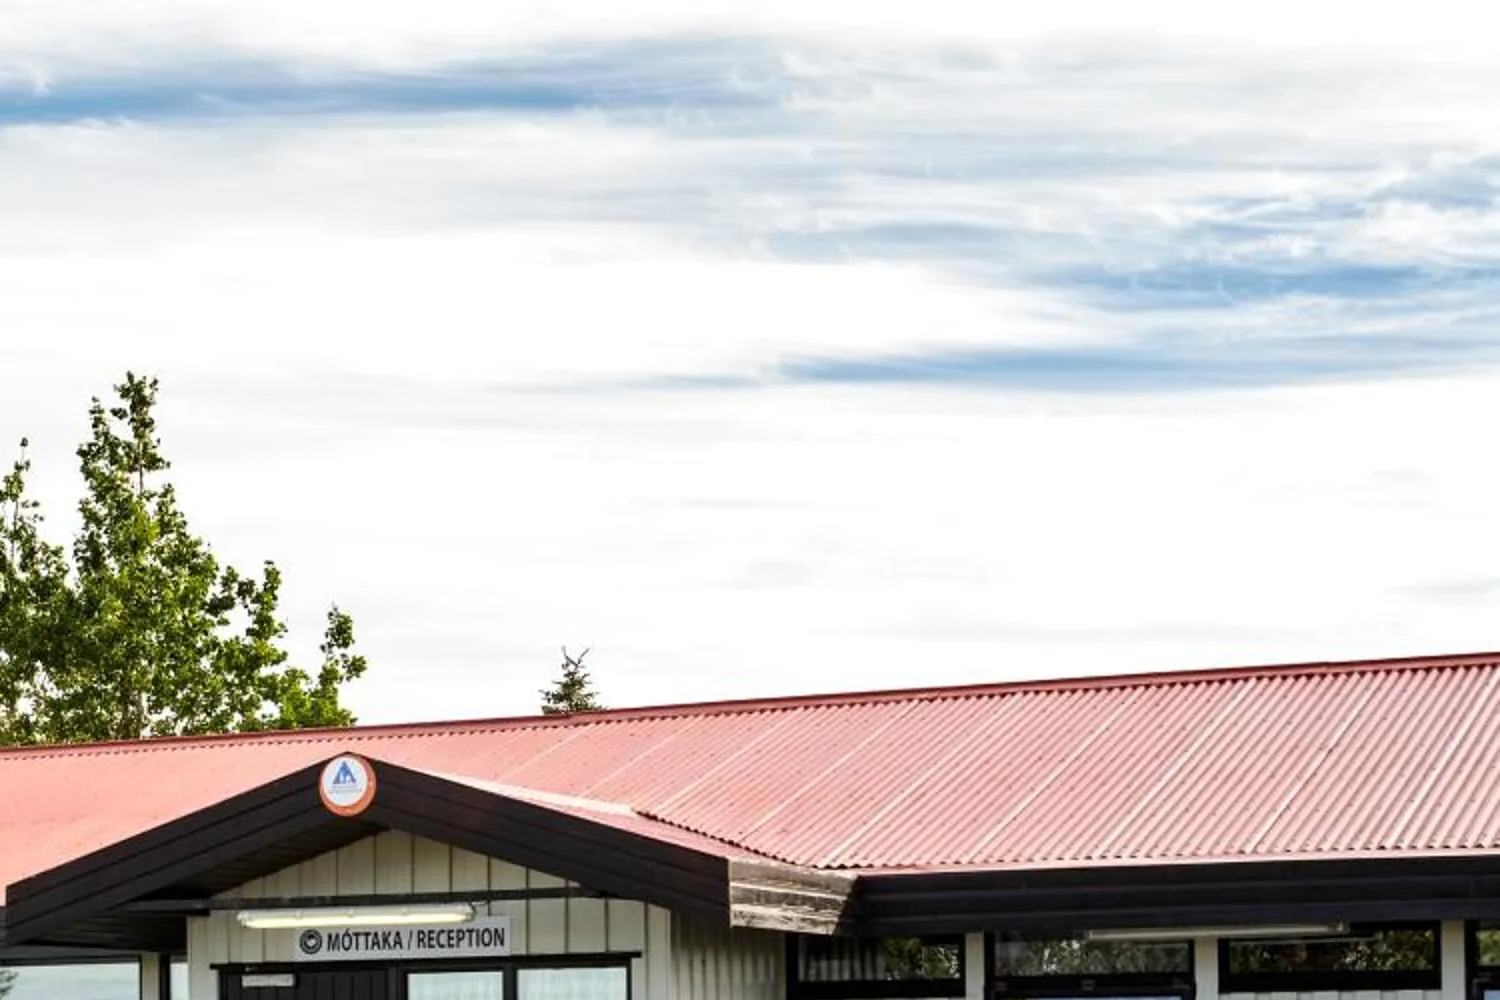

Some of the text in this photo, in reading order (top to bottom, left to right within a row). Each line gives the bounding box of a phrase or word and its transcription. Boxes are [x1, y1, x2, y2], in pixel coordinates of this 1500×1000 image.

[327, 927, 505, 952] MÓTTAKA / RECEPTION
